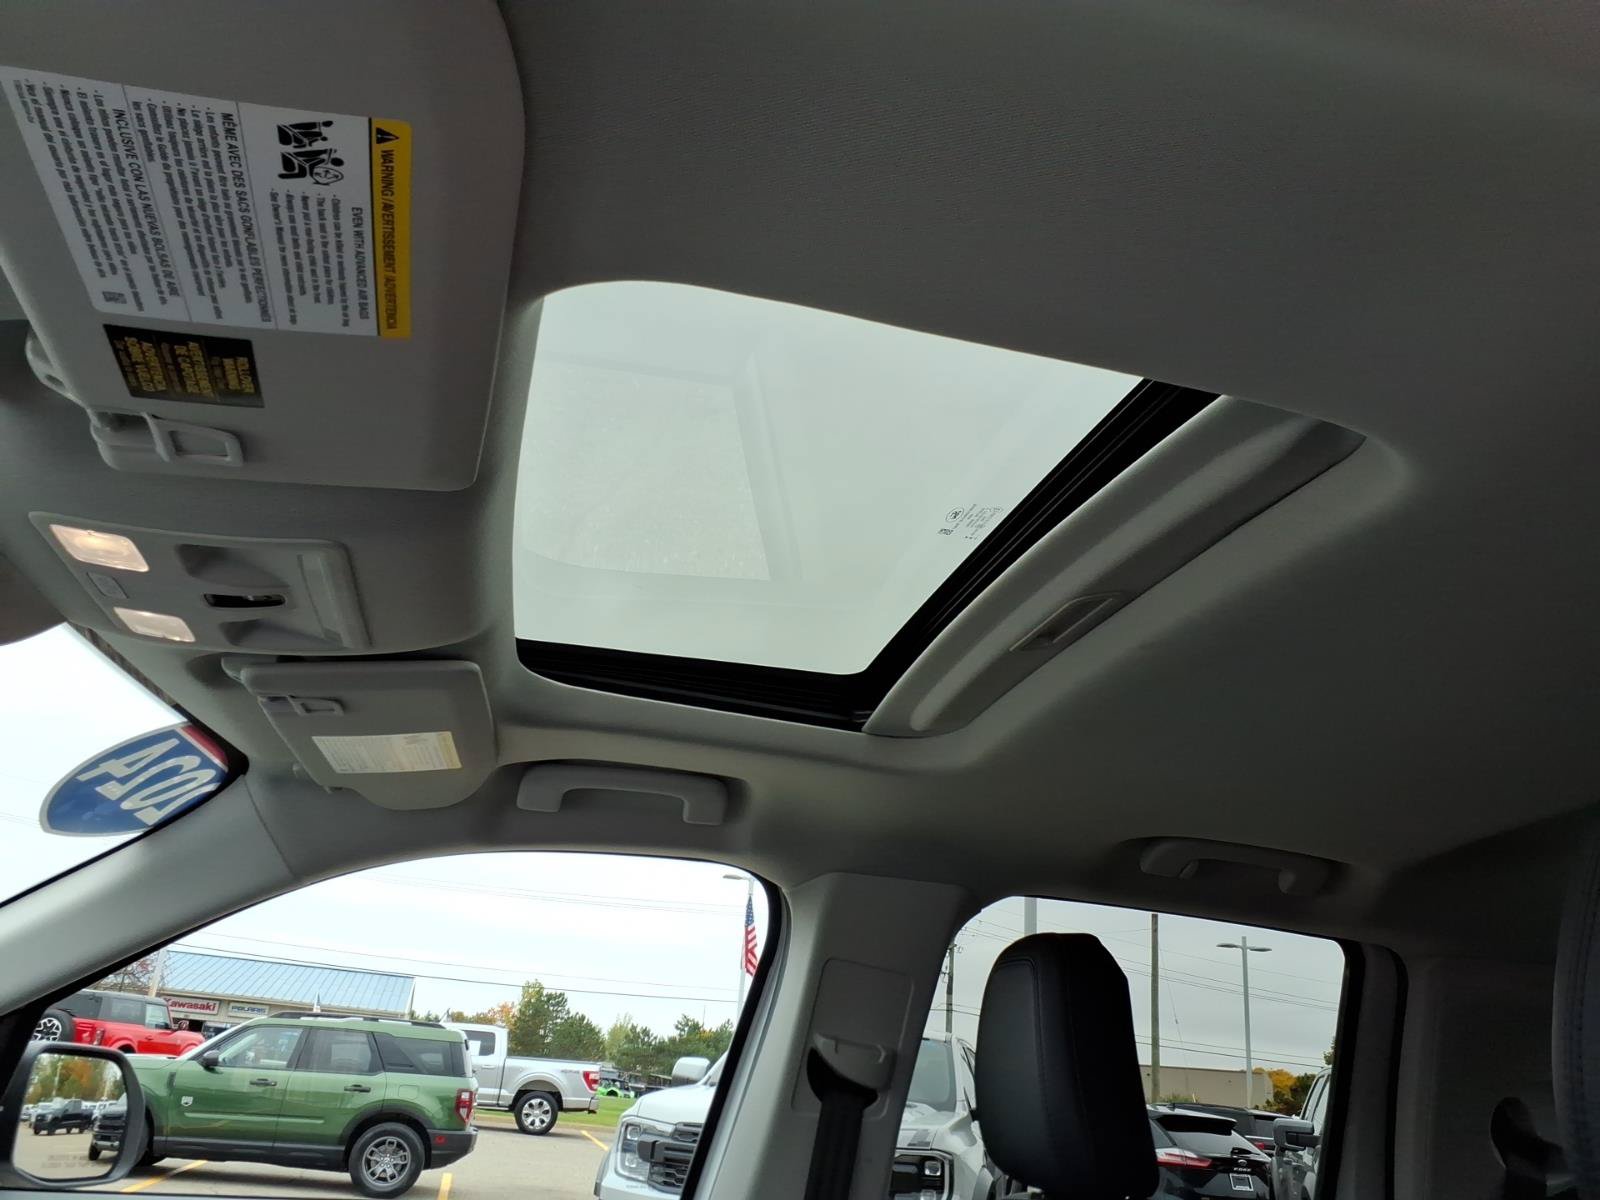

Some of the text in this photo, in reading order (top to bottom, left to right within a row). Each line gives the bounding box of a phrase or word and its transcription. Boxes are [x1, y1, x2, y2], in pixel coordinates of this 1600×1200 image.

[113, 109, 138, 160] INCLUSIVE
[221, 113, 237, 141] MÊME
[227, 143, 242, 168] AVEC
[128, 162, 144, 182] CON
[231, 170, 246, 188] DES
[381, 150, 394, 196] WARNING
[135, 184, 150, 201] LAS
[235, 190, 250, 213] SACS
[142, 203, 160, 235] NUEVAS
[352, 207, 363, 228] EVEN
[354, 230, 364, 248] WITH
[152, 237, 170, 268] BOLSAS
[162, 270, 174, 279] DE
[355, 250, 367, 288] ADVANCED
[358, 289, 368, 300] AIR
